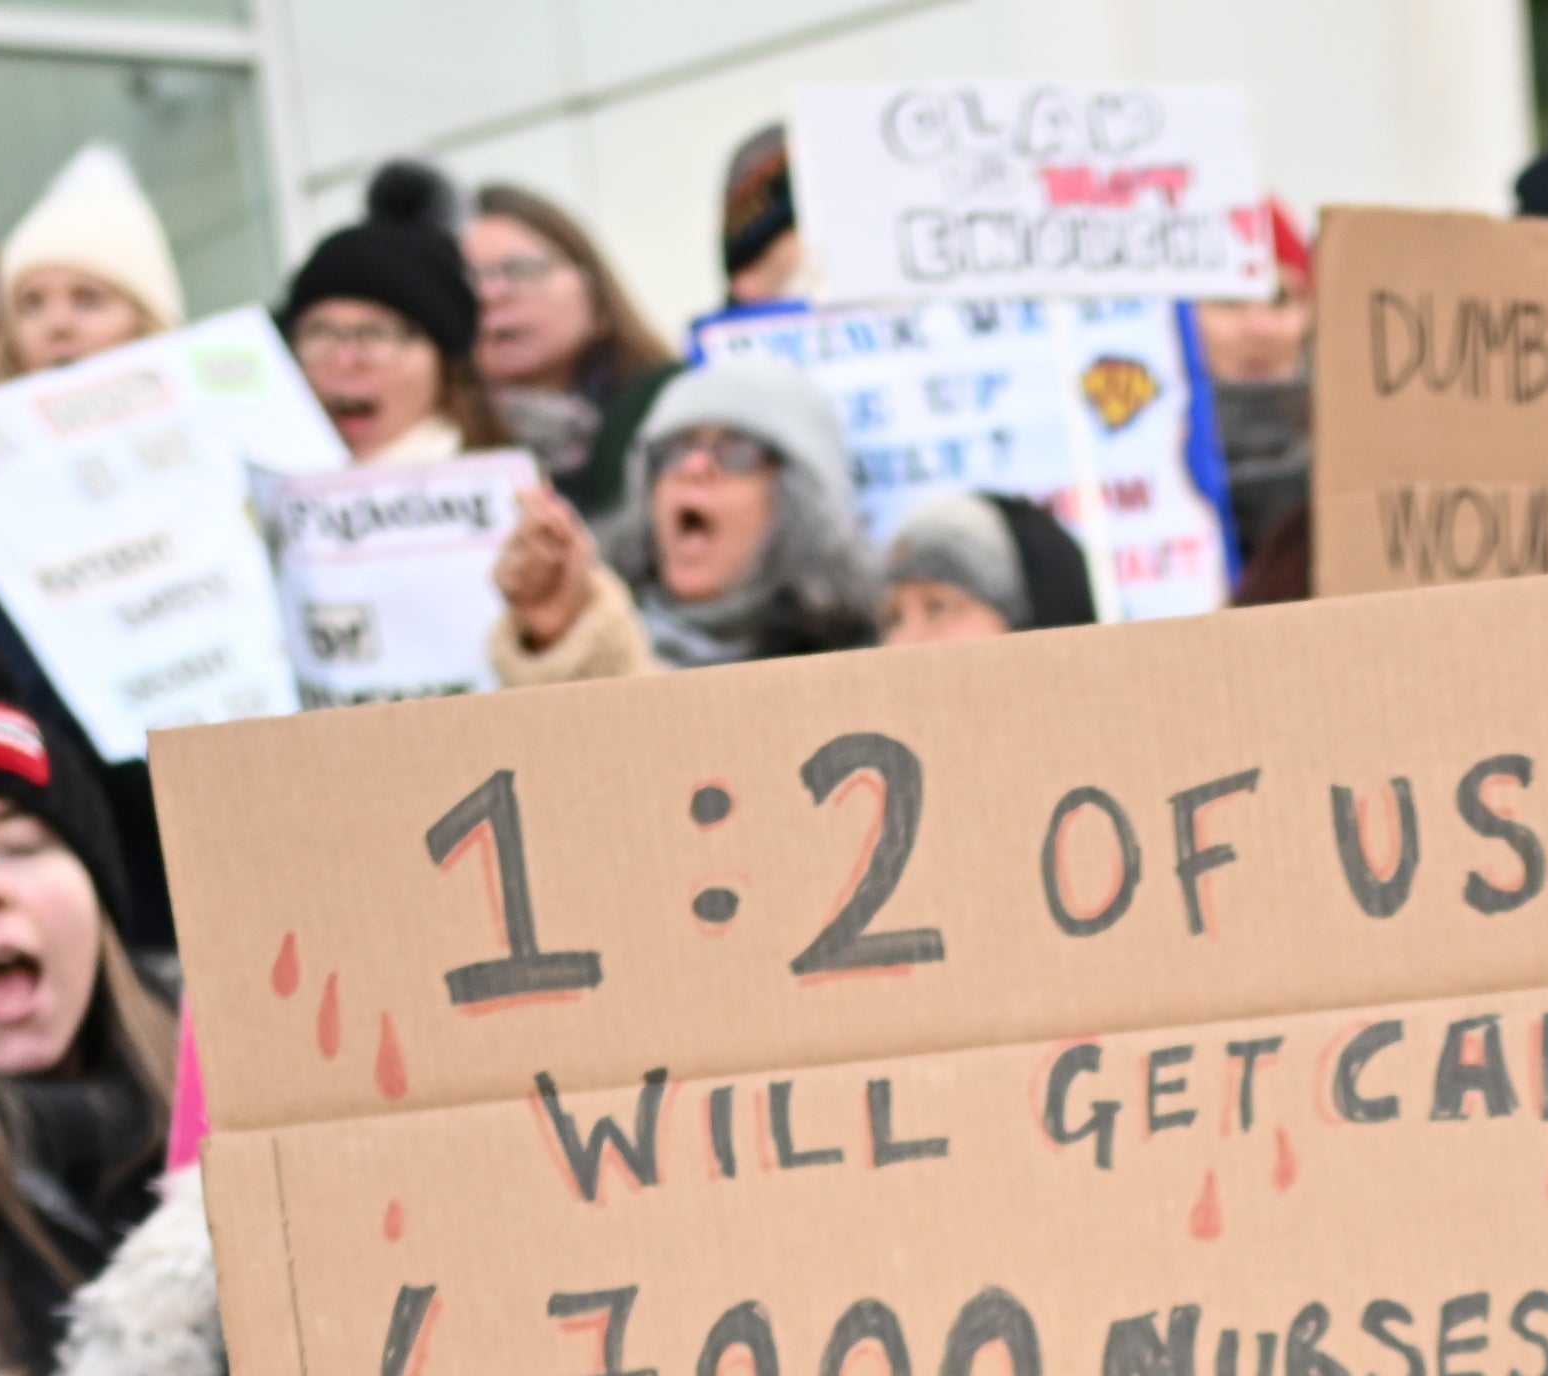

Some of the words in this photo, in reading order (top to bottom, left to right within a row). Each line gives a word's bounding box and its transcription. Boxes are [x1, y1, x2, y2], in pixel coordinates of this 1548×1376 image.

[1039, 767, 1262, 938] OF
[1328, 752, 1548, 918] US
[532, 1064, 950, 1203] WILL
[1040, 1034, 1286, 1170] GET
